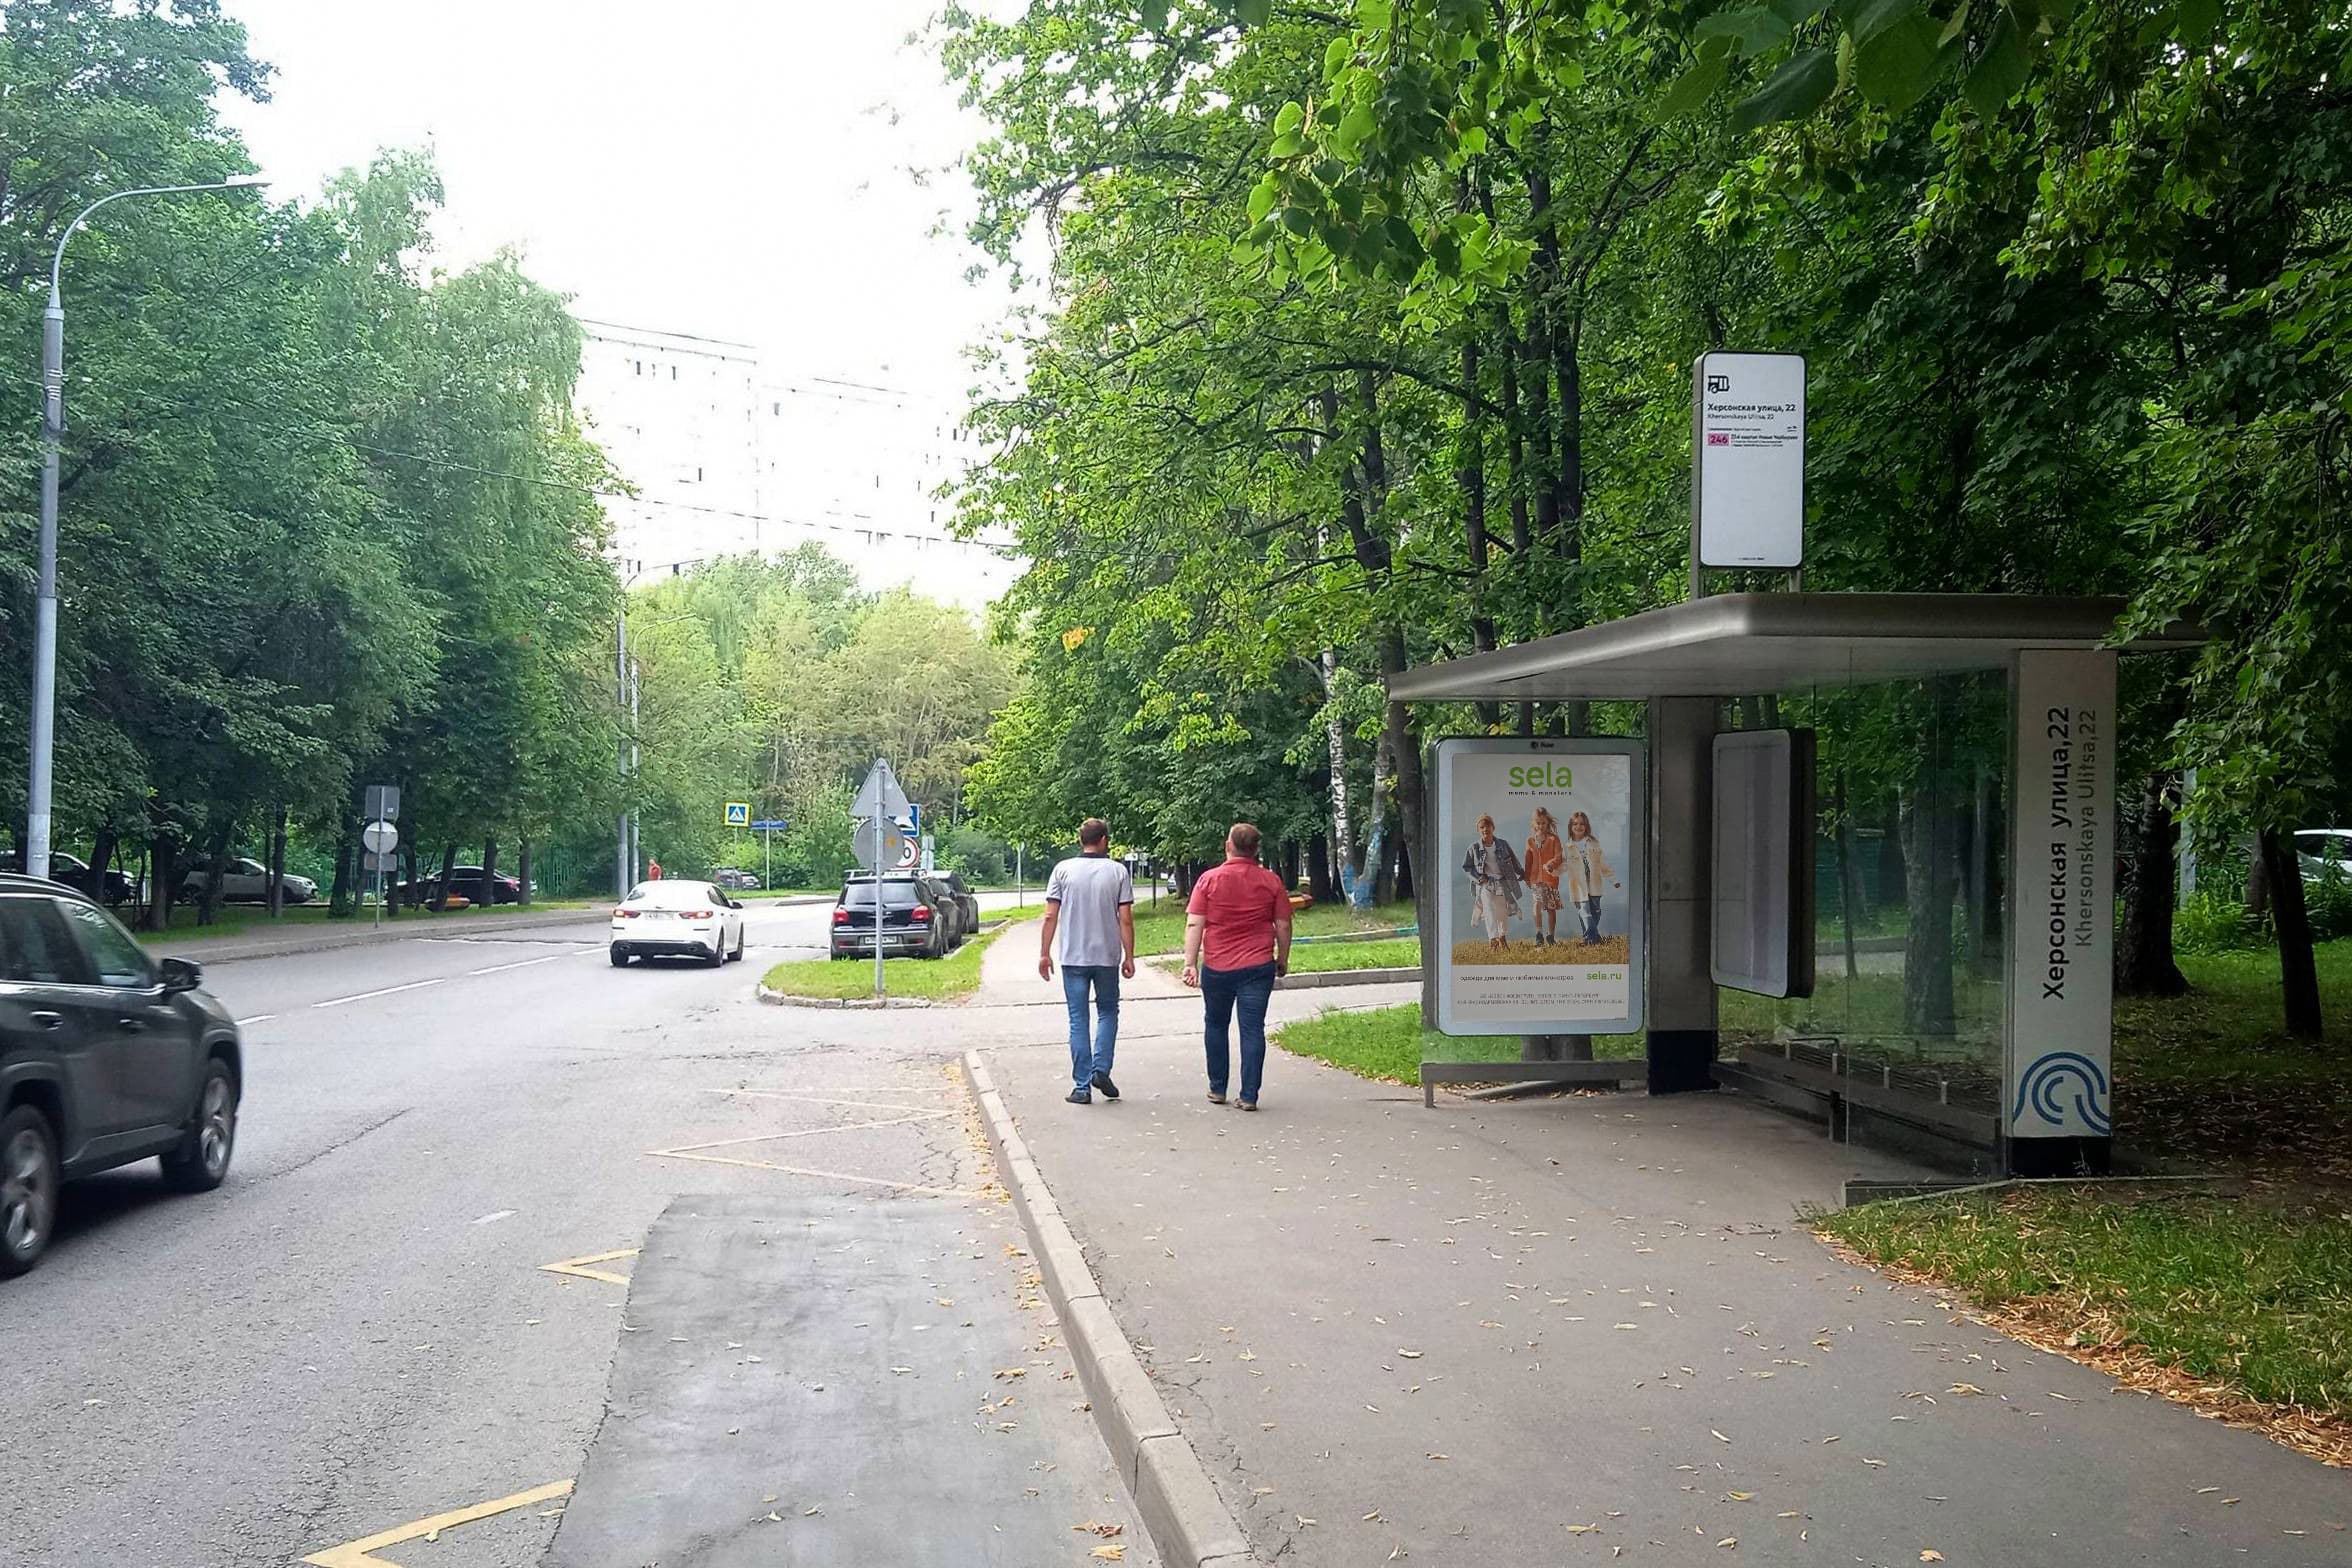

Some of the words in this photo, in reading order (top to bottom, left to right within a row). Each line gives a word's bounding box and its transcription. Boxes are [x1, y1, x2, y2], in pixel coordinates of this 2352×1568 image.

[1707, 403, 1755, 413] Херсонская
[1757, 404, 1784, 413] улица,
[1785, 403, 1796, 412] 22
[1710, 434, 1728, 444] 246
[1509, 760, 1573, 788] sela
[2047, 707, 2073, 829] улица,22
[2077, 709, 2099, 799] Ulitsa,22
[2075, 806, 2099, 947] Khersonskaya
[2043, 842, 2070, 1000] Херсонская
[1586, 970, 1622, 981] sela.ru
